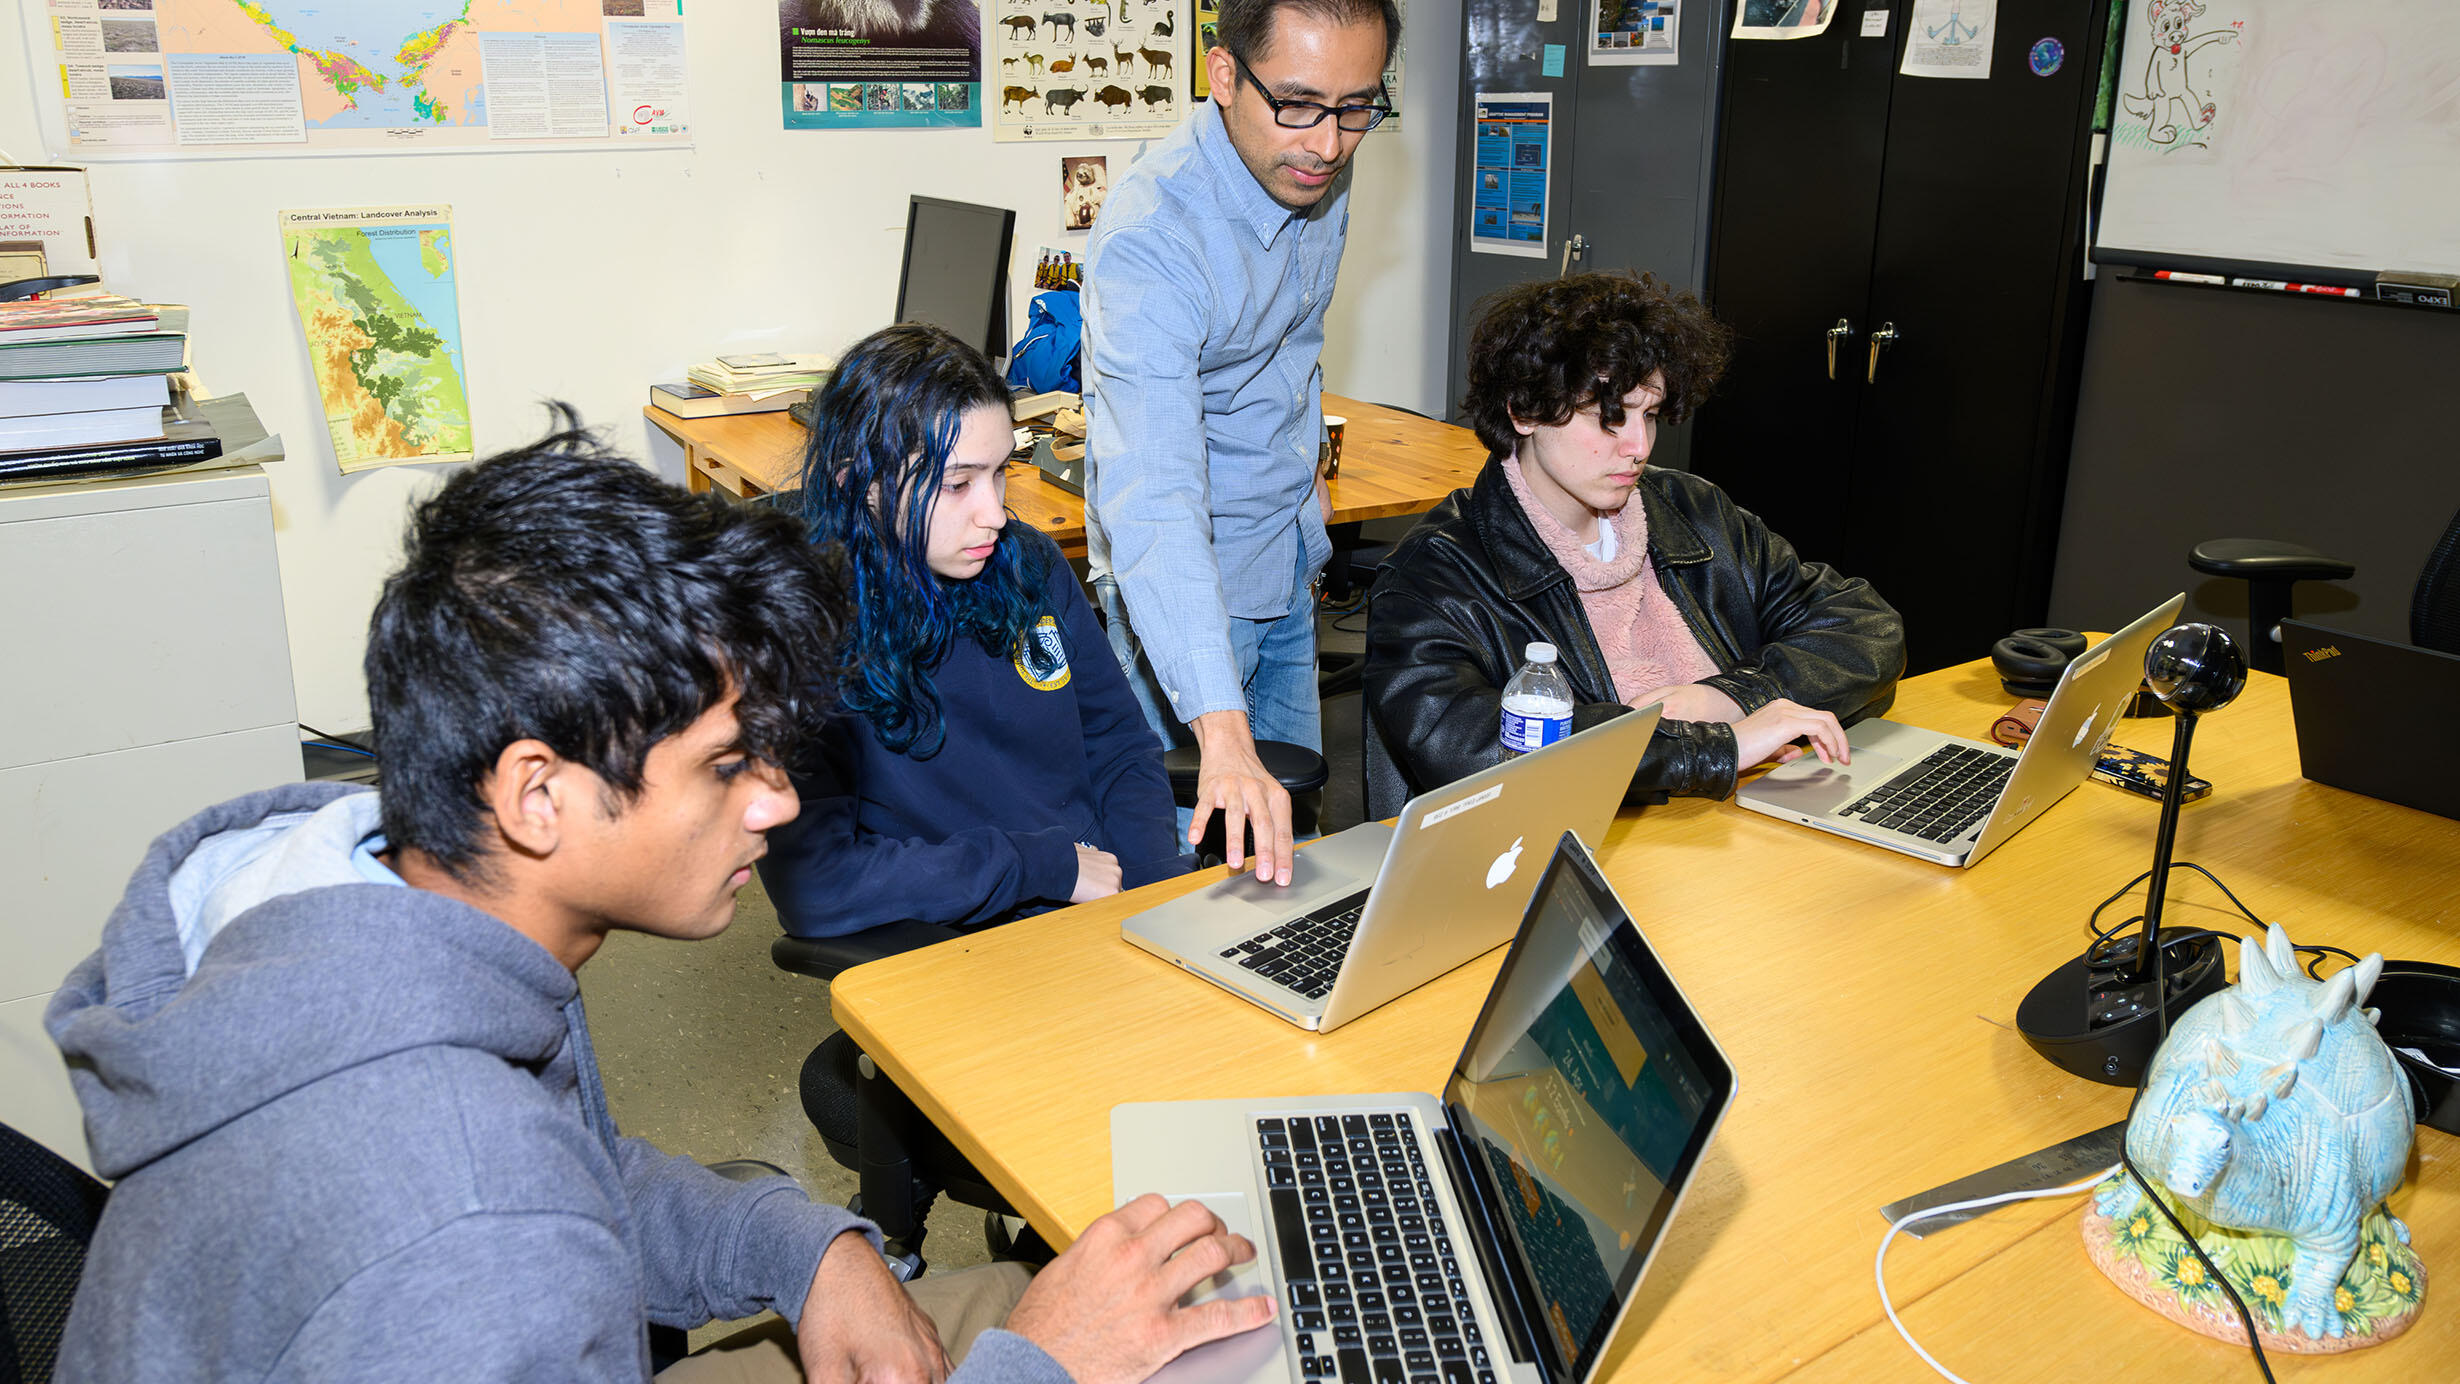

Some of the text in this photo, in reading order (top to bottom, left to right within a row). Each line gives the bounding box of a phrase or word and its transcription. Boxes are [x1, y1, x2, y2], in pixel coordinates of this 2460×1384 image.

[801, 36, 871, 45] Nomascus leucogenys
[290, 209, 438, 221] Central Vietnam: Landcover Analysis
[380, 228, 416, 236] Distribution
[2418, 295, 2448, 305] EXPO
[2302, 645, 2342, 663] ThinkPad
